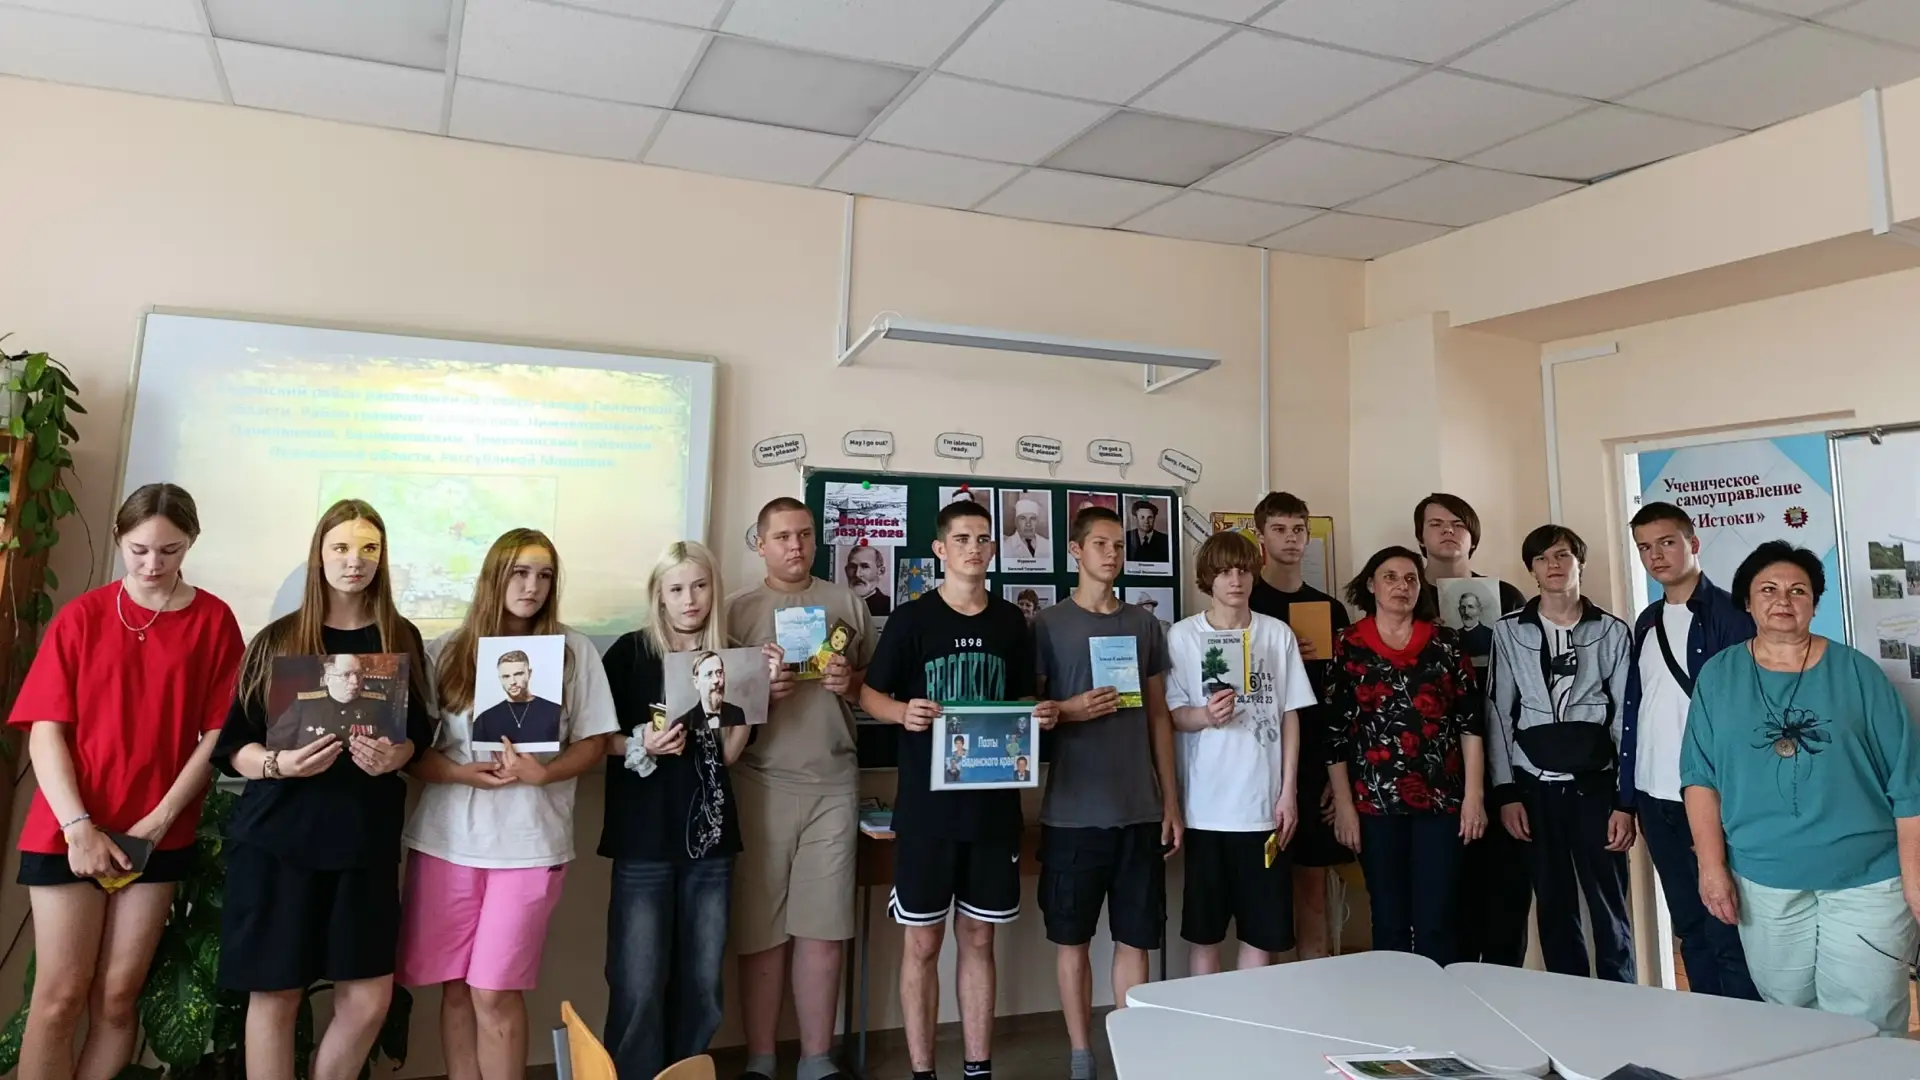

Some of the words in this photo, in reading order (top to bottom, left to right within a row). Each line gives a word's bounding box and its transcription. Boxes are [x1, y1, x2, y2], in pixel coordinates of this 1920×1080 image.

[773, 443, 784, 451] you
[785, 440, 799, 448] help
[762, 451, 775, 459] me,
[776, 446, 800, 457] please?
[1036, 448, 1058, 456] please?
[1663, 474, 1760, 493] Ученическое
[1676, 482, 1802, 508] самоуправление
[1690, 512, 1766, 528] «Истоки»
[954, 638, 982, 647] 1898
[1265, 696, 1273, 704] 23
[978, 736, 998, 748] Поэты
[962, 756, 998, 768] Вадинского
